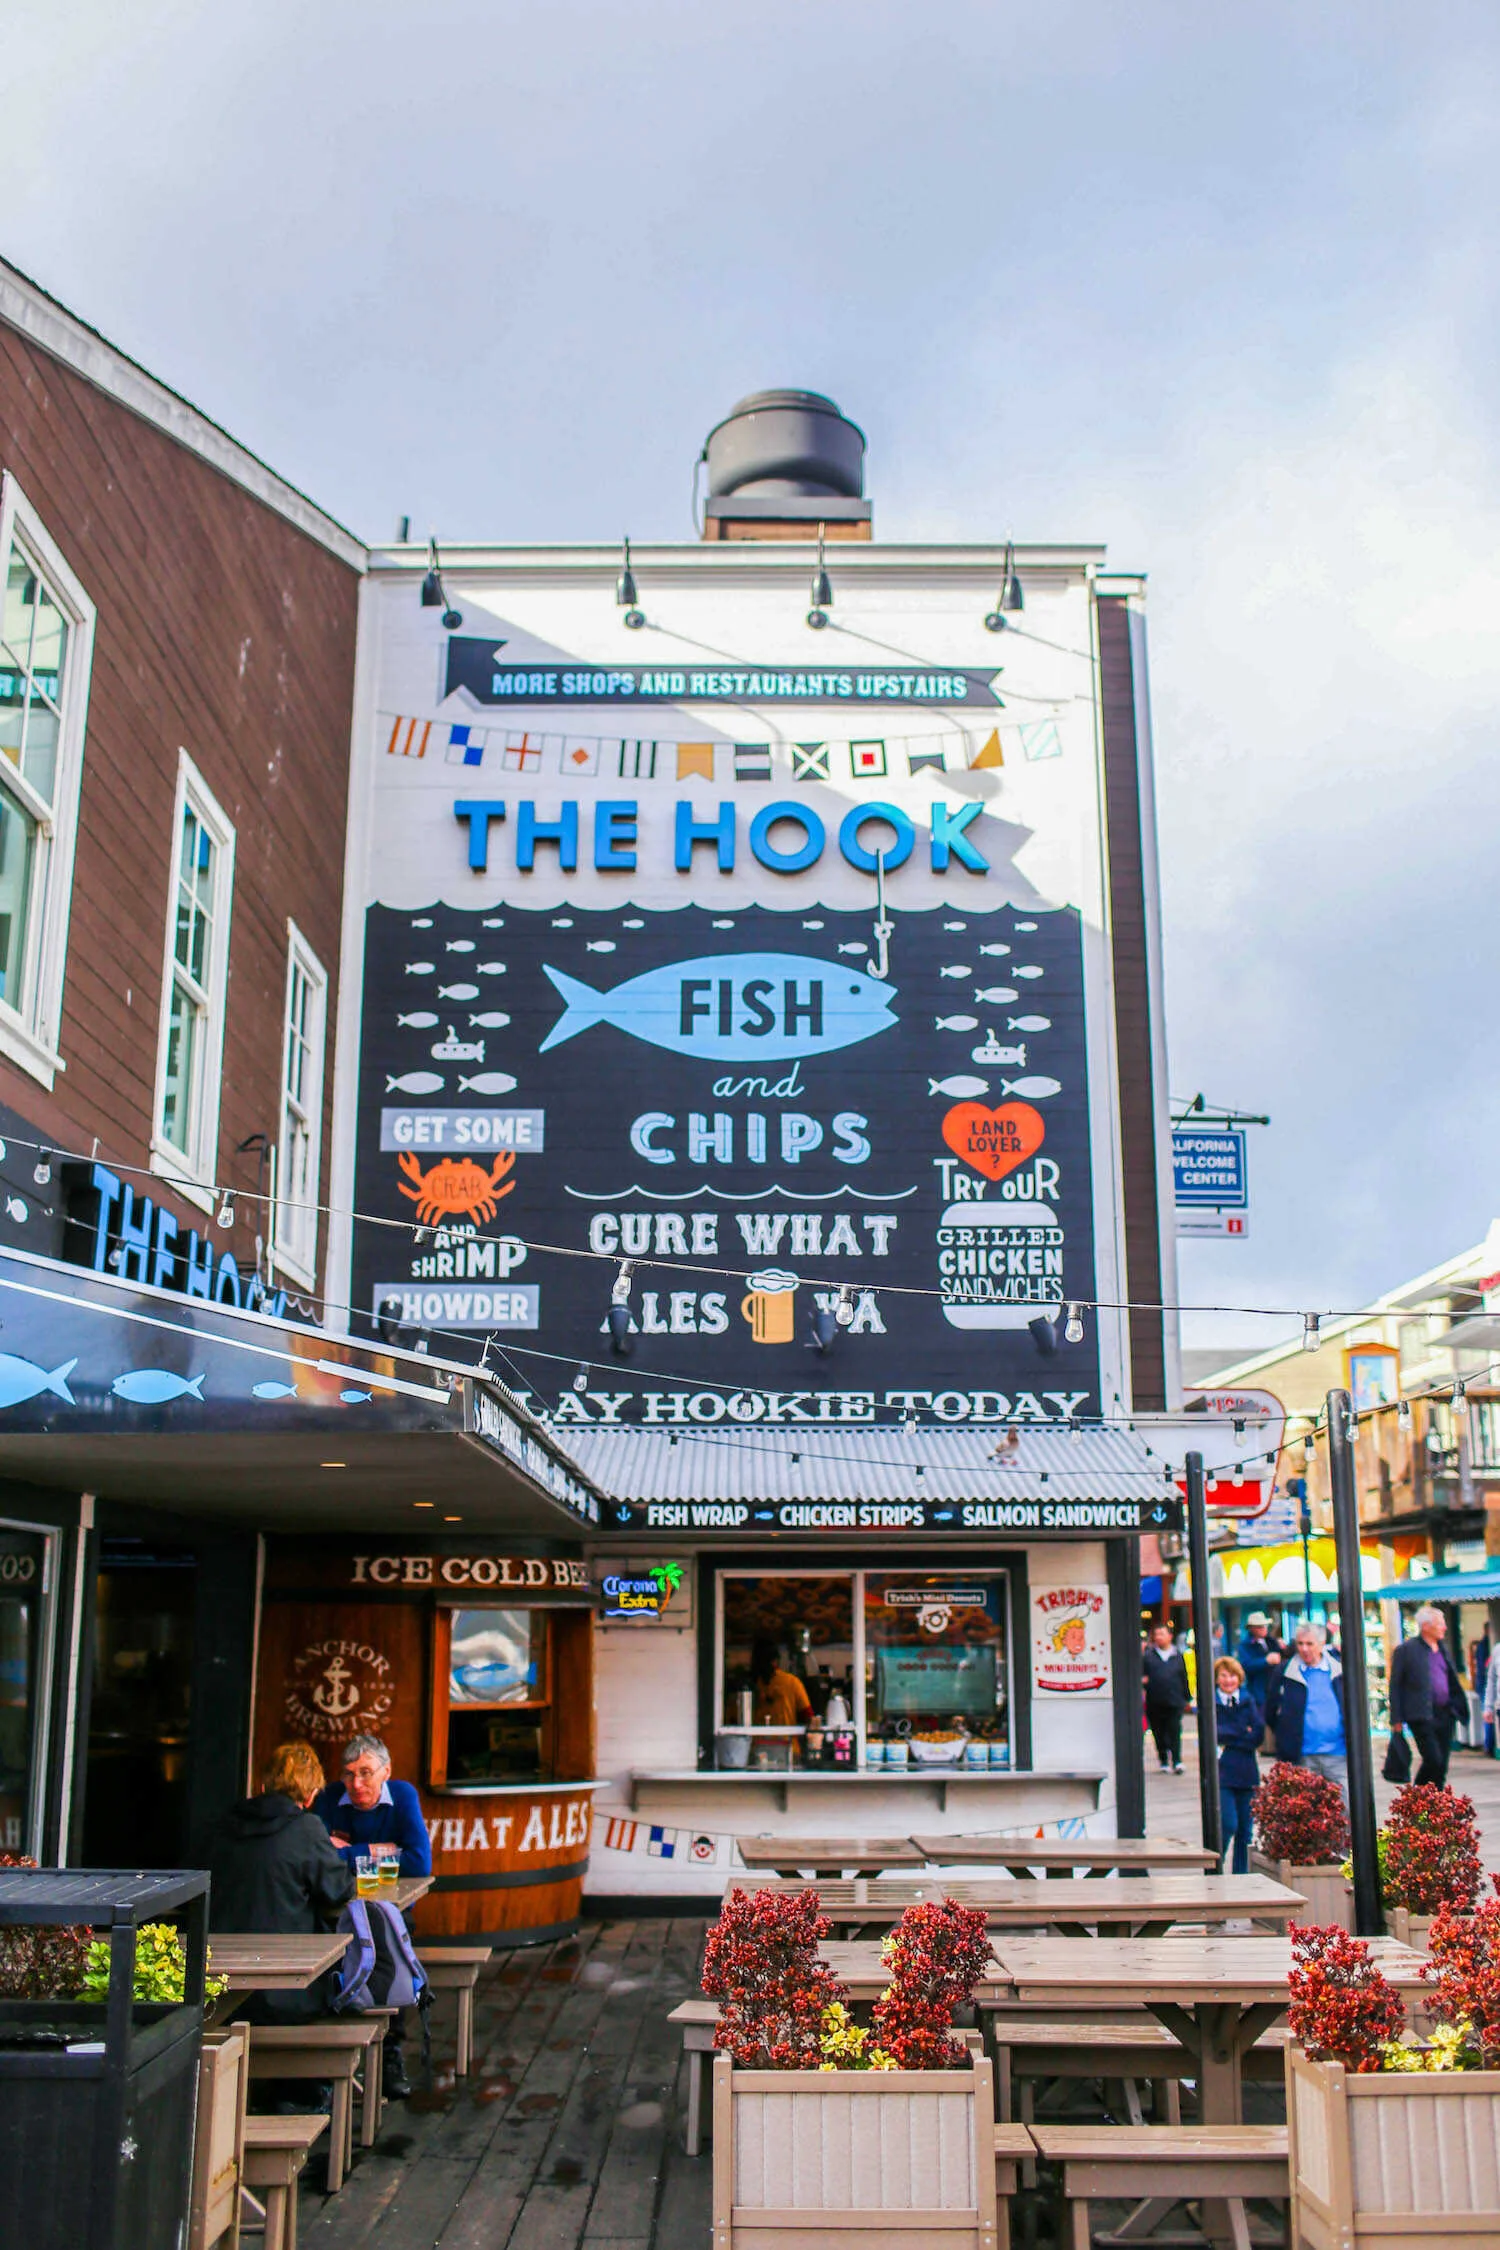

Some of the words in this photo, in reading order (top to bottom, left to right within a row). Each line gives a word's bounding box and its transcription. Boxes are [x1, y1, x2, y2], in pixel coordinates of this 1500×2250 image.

[492, 672, 557, 696] MORE
[562, 672, 635, 696] SHOPS
[639, 672, 685, 696] AND
[690, 672, 852, 698] RESTAURANTS
[856, 674, 967, 699] UPSTAIRS
[454, 800, 637, 873] THE
[674, 800, 990, 875] HOOK
[680, 979, 823, 1037] FISH
[712, 1061, 805, 1098] and
[393, 1115, 448, 1144] GET
[454, 1116, 533, 1145] SOME
[630, 1112, 872, 1165] CHIPS
[971, 1120, 1017, 1136] LAND
[968, 1137, 1022, 1152] LOVER
[1172, 1139, 1236, 1152] ALIFORNIA
[992, 1153, 1001, 1169] ?
[431, 1174, 484, 1200] CRAB
[1183, 1172, 1237, 1185] CENTER
[93, 1163, 179, 1288] THE
[434, 1223, 477, 1249] AND
[589, 1213, 718, 1255] CURE
[735, 1214, 898, 1256] WHAT
[936, 1228, 1065, 1246] GRILLED
[411, 1235, 528, 1278] SHRIMP
[938, 1248, 1064, 1276] CHICKEN
[939, 1276, 1064, 1304] SANDWICHES
[512, 1392, 633, 1423] LAY
[642, 1391, 875, 1423] HOOKIE
[885, 1390, 1090, 1423] TODAY
[648, 1504, 689, 1527] FISH
[691, 1504, 748, 1527] WRAP
[779, 1504, 857, 1527] CHICKEN
[859, 1504, 925, 1527] STRIPS
[962, 1504, 1040, 1527] SALMON
[1042, 1504, 1140, 1527] SANDWICH
[351, 1556, 433, 1584] ICE
[440, 1558, 549, 1585] COLD
[602, 1574, 658, 1597] Corona
[618, 1592, 658, 1609] Extra
[1034, 1588, 1104, 1613] TRISH'S
[293, 1640, 391, 1677] ANCHOR
[285, 1694, 393, 1733] BREWING
[518, 1801, 590, 1852] ALES
